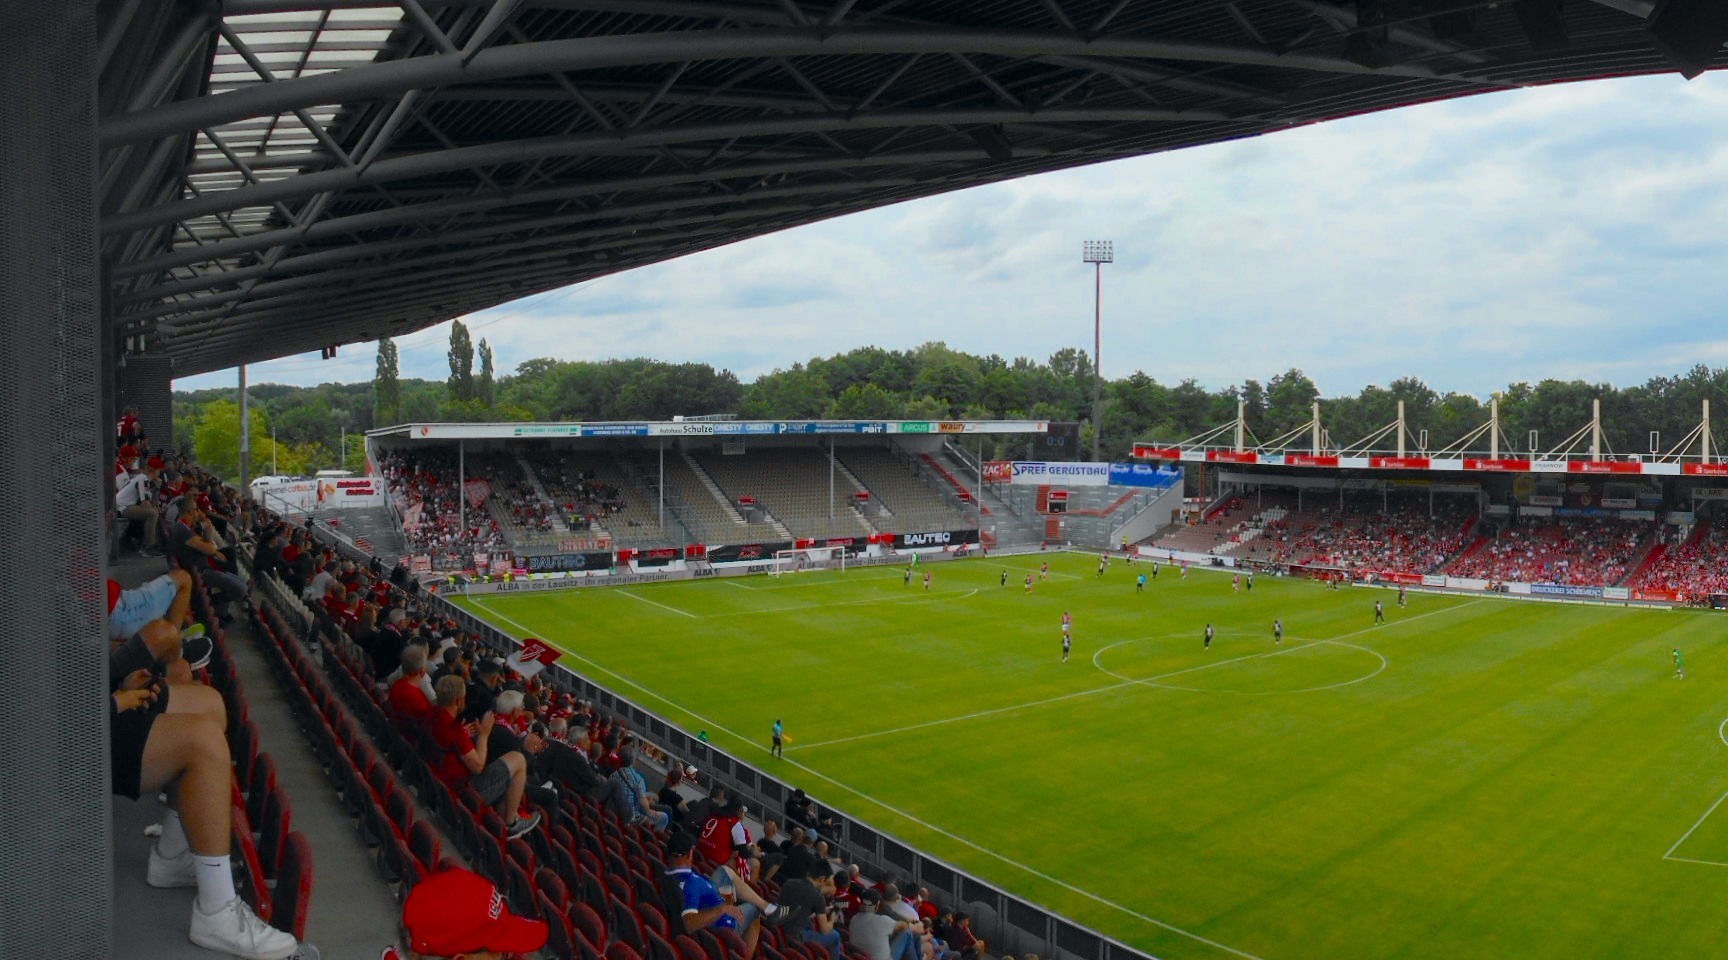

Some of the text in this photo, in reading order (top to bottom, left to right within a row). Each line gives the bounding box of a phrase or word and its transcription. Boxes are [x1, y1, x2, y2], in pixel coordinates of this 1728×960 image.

[683, 425, 713, 434] Schulze
[903, 424, 928, 433] ARCUS
[941, 424, 966, 434] waury
[1046, 436, 1065, 446] 0:0
[1012, 462, 1046, 476] SPREE
[1048, 464, 1107, 476] GERÜSTBAU
[694, 569, 712, 577] ALBA
[747, 565, 765, 573] ALBA
[496, 583, 520, 592] ALBA
[532, 581, 545, 590] der
[548, 580, 578, 589] Lausitz
[598, 576, 638, 586] regionaler
[639, 573, 670, 583] Partner.
[1531, 585, 1566, 594] DRUCKEREI
[702, 818, 718, 839] 9
